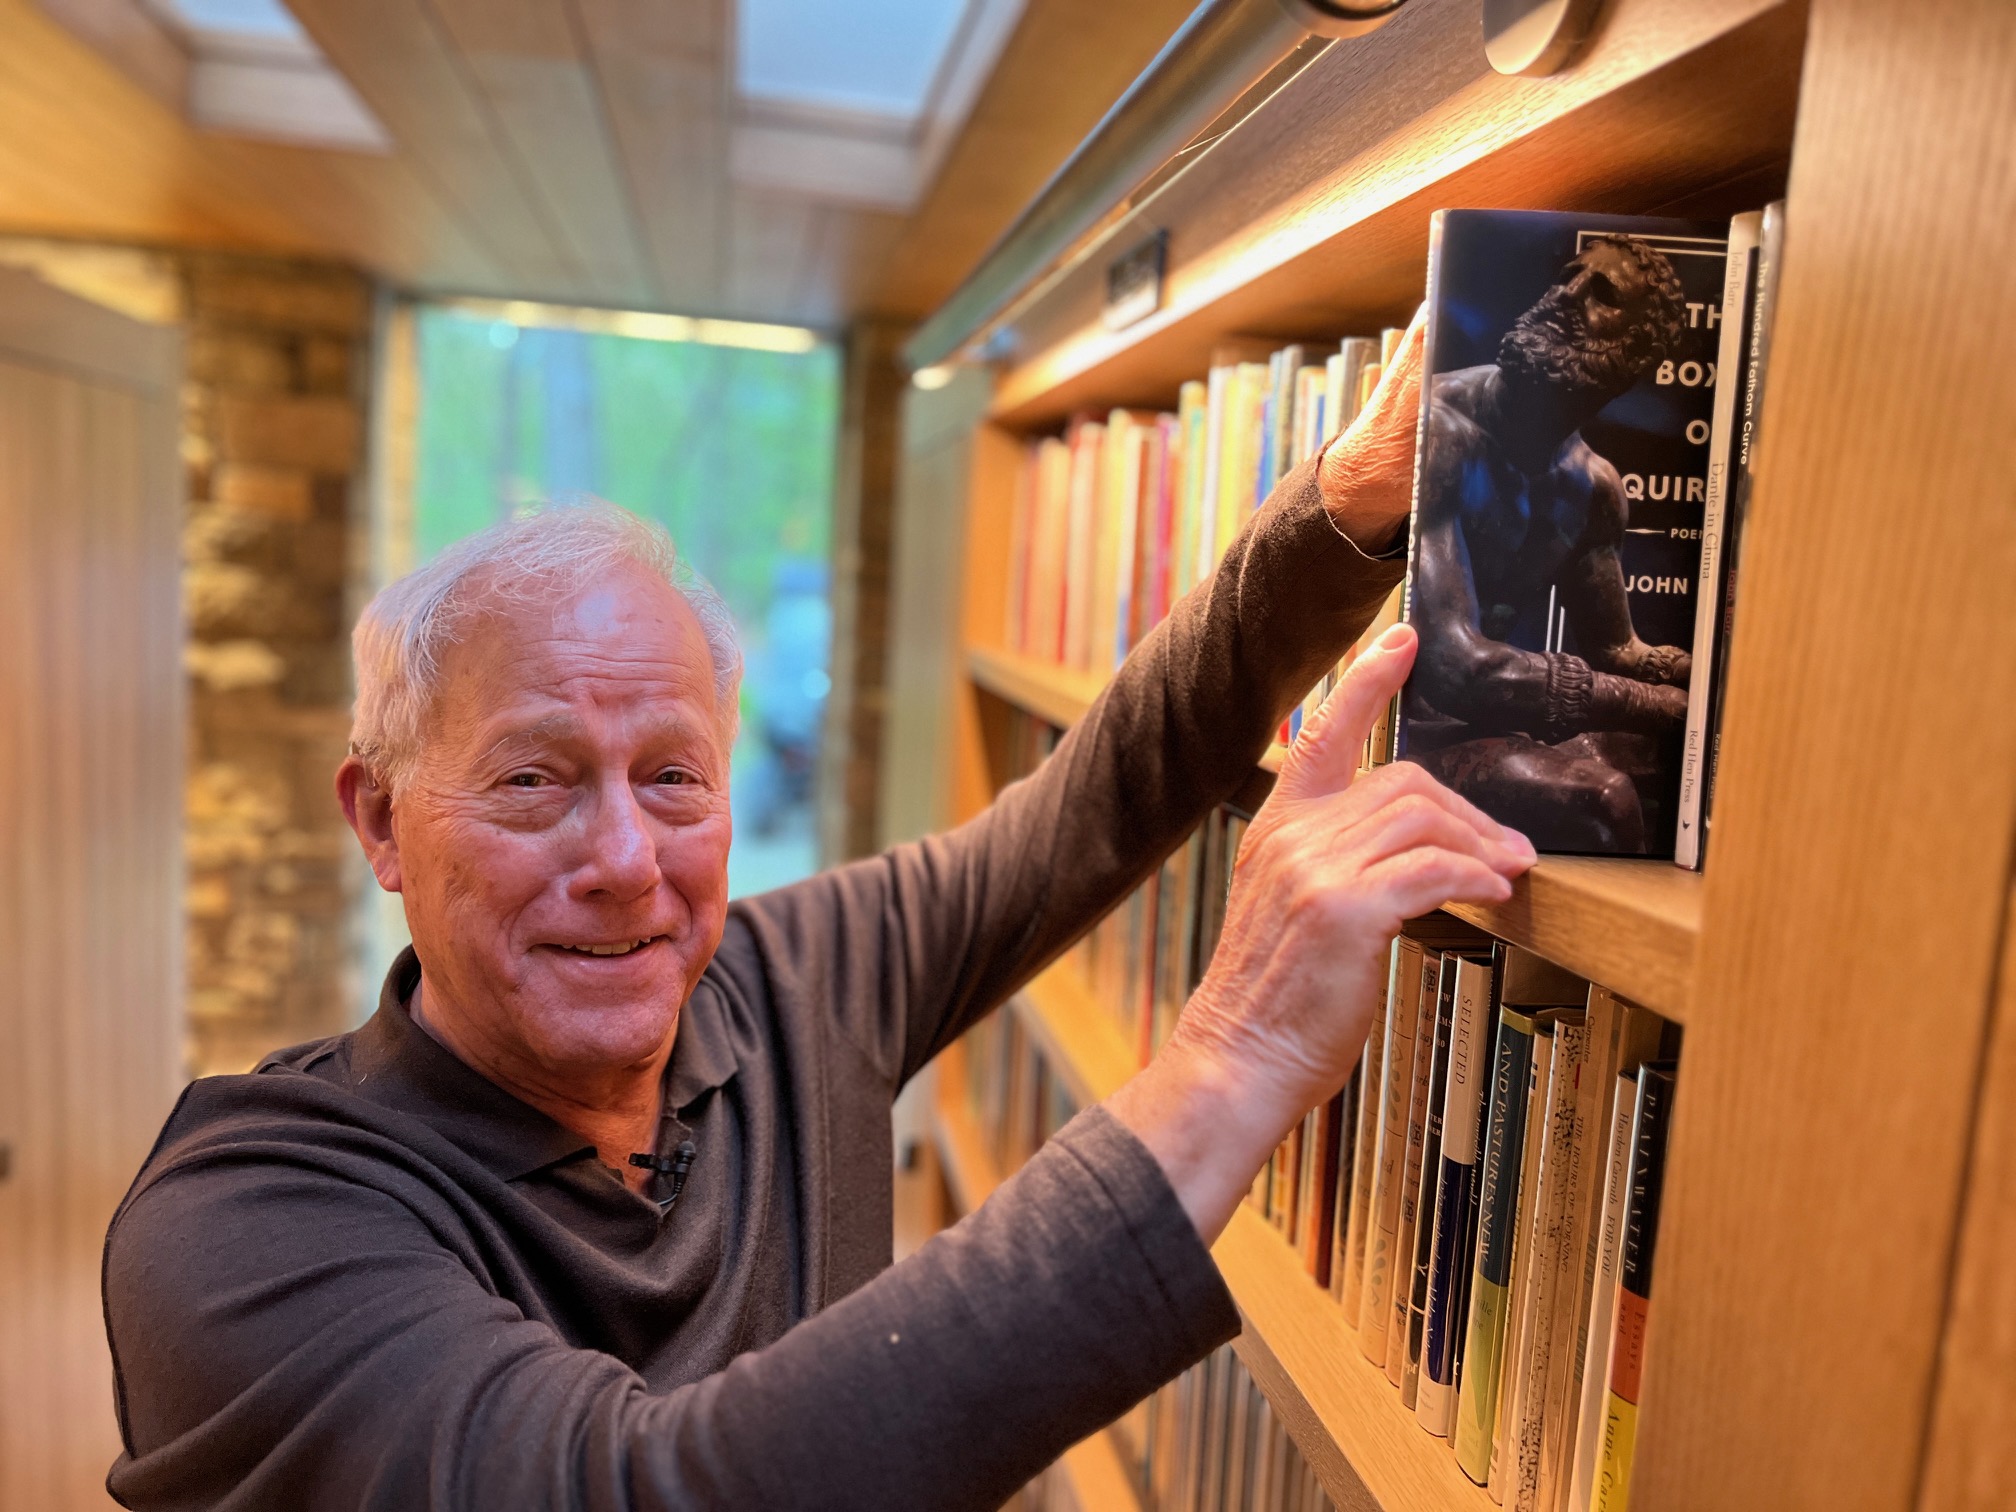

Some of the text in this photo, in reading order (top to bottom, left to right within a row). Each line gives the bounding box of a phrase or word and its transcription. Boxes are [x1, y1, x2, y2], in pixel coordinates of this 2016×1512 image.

[1727, 251, 1743, 308] John Barr
[1740, 261, 1768, 465] The Hundred Fathom Curve
[1702, 462, 1724, 579] Dante in China
[1625, 575, 1688, 595] JOHN
[1684, 730, 1699, 803] Red Hen Press
[1455, 995, 1473, 1085] SELECTED
[1584, 1015, 1595, 1064] Carpenter
[1479, 1042, 1512, 1263] AND PASTURES NEW
[1560, 1116, 1584, 1274] THE HOURS OF MORNING
[1601, 1112, 1630, 1278] Hayden Carruth FOR YOU
[1624, 1093, 1656, 1274] PLAINWATER
[1618, 1303, 1627, 1335] and
[1629, 1311, 1646, 1370] Essays
[1599, 1405, 1621, 1512] Anne Car
